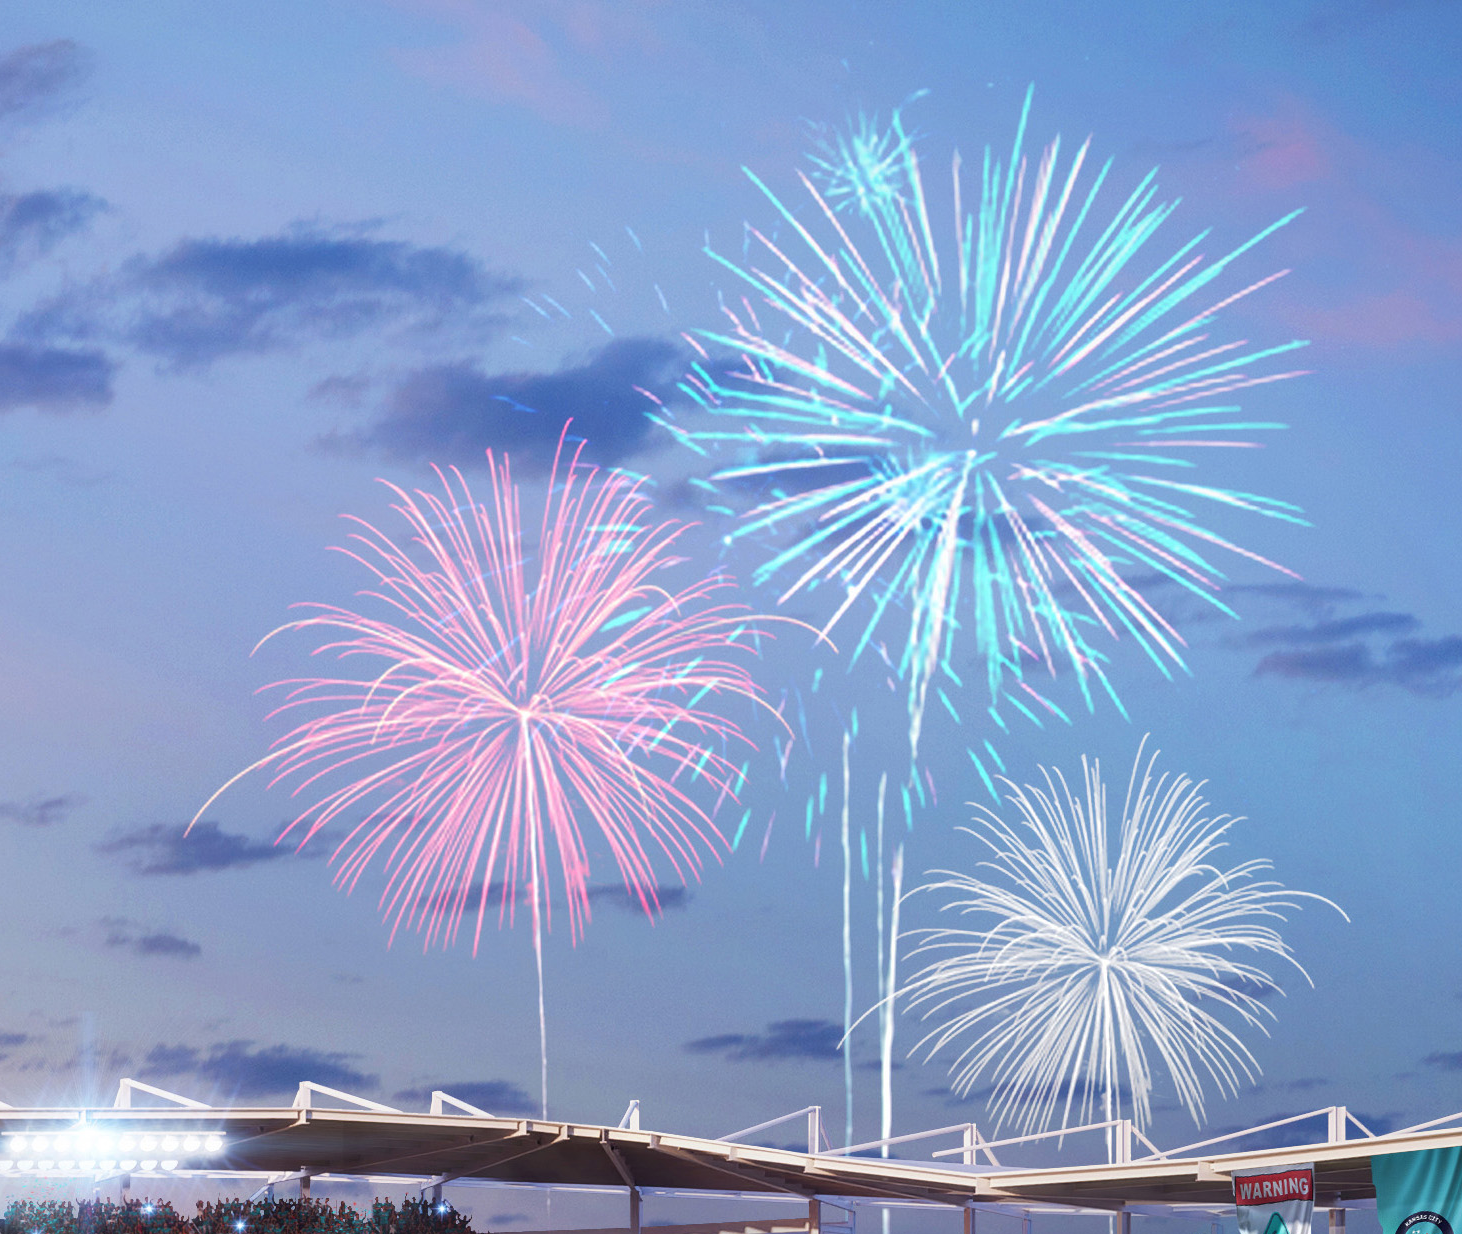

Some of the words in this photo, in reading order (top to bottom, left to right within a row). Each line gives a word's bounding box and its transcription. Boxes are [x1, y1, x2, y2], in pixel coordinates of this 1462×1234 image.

[1240, 1178, 1309, 1200] WARNING
[1404, 1214, 1427, 1227] KANSAS
[1428, 1215, 1443, 1225] CITY
